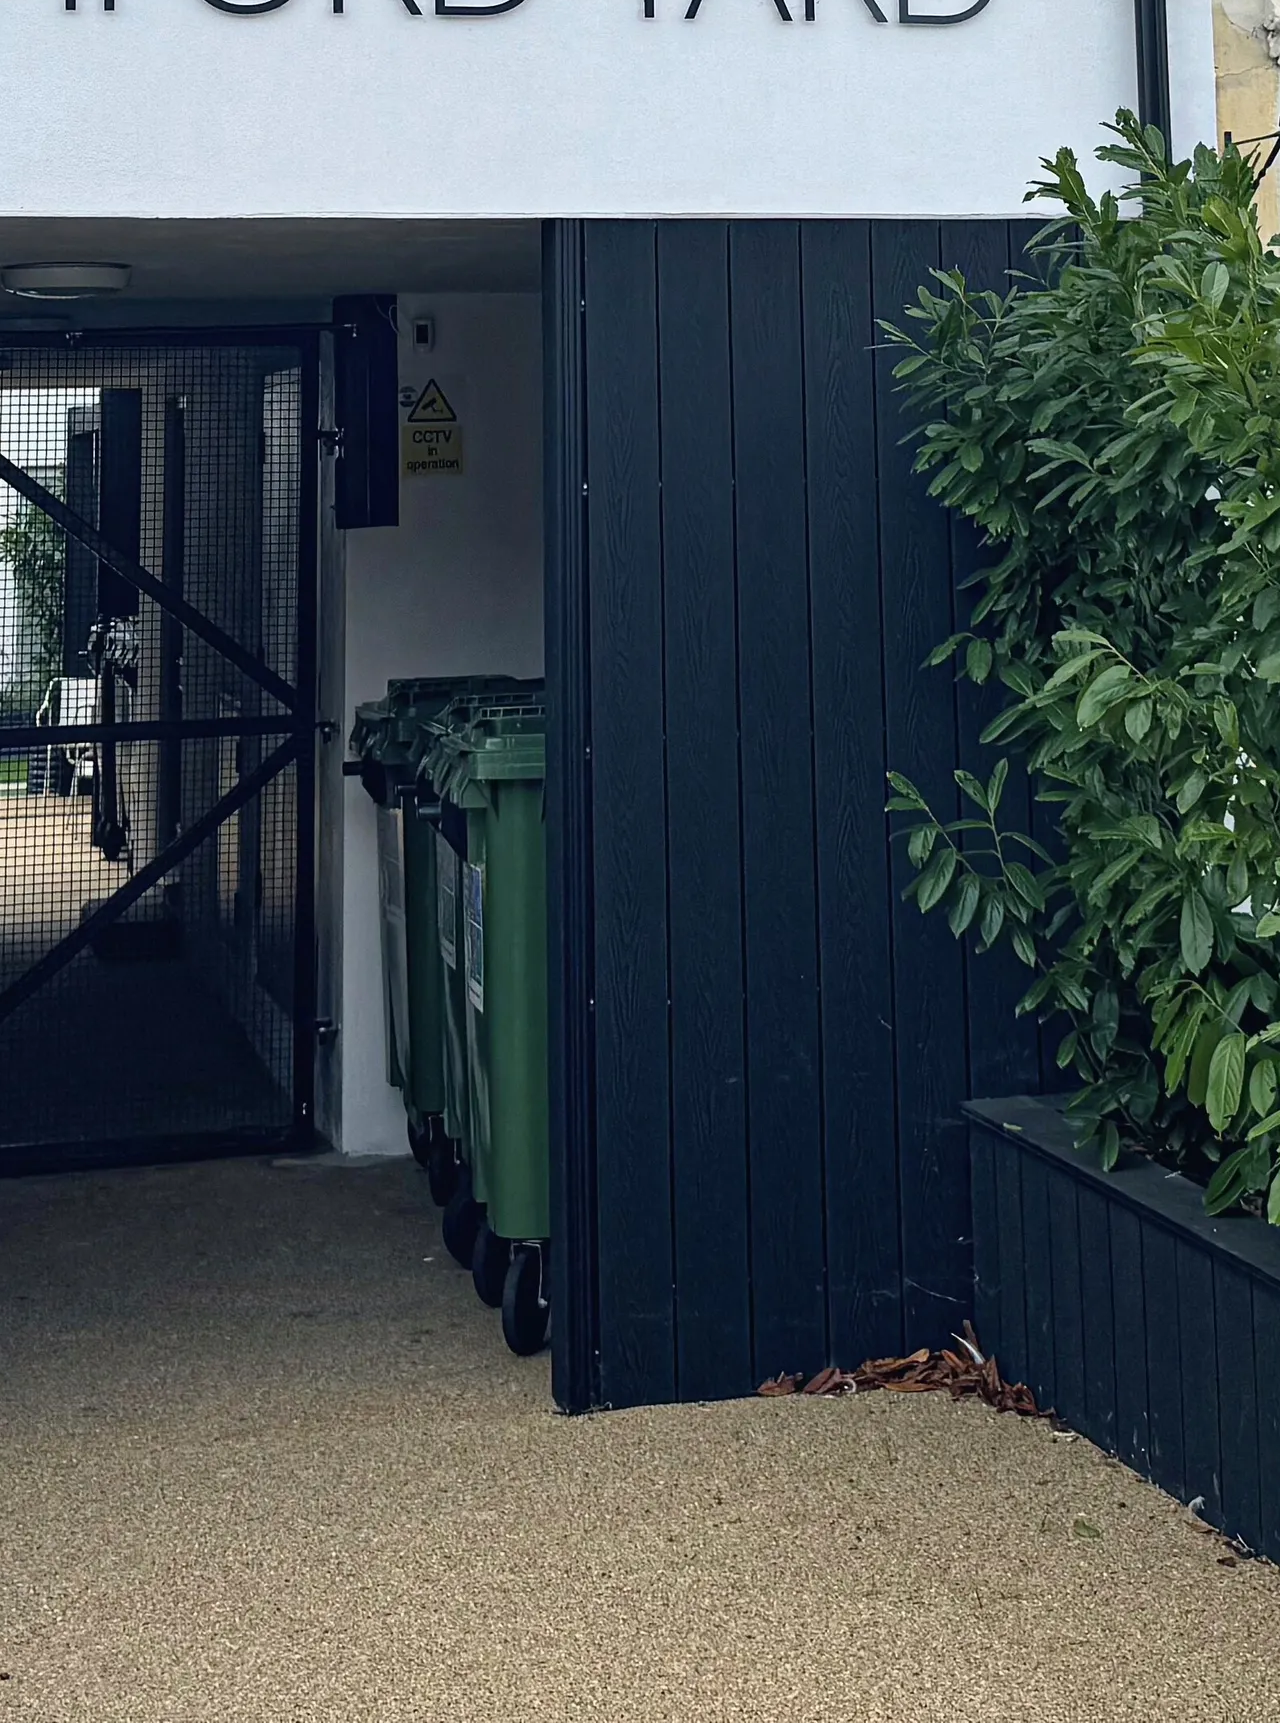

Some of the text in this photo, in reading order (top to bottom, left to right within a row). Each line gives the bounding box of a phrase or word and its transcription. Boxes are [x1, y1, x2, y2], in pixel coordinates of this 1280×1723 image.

[412, 430, 452, 443] CCTV
[427, 445, 438, 456] in
[406, 458, 460, 473] operation
